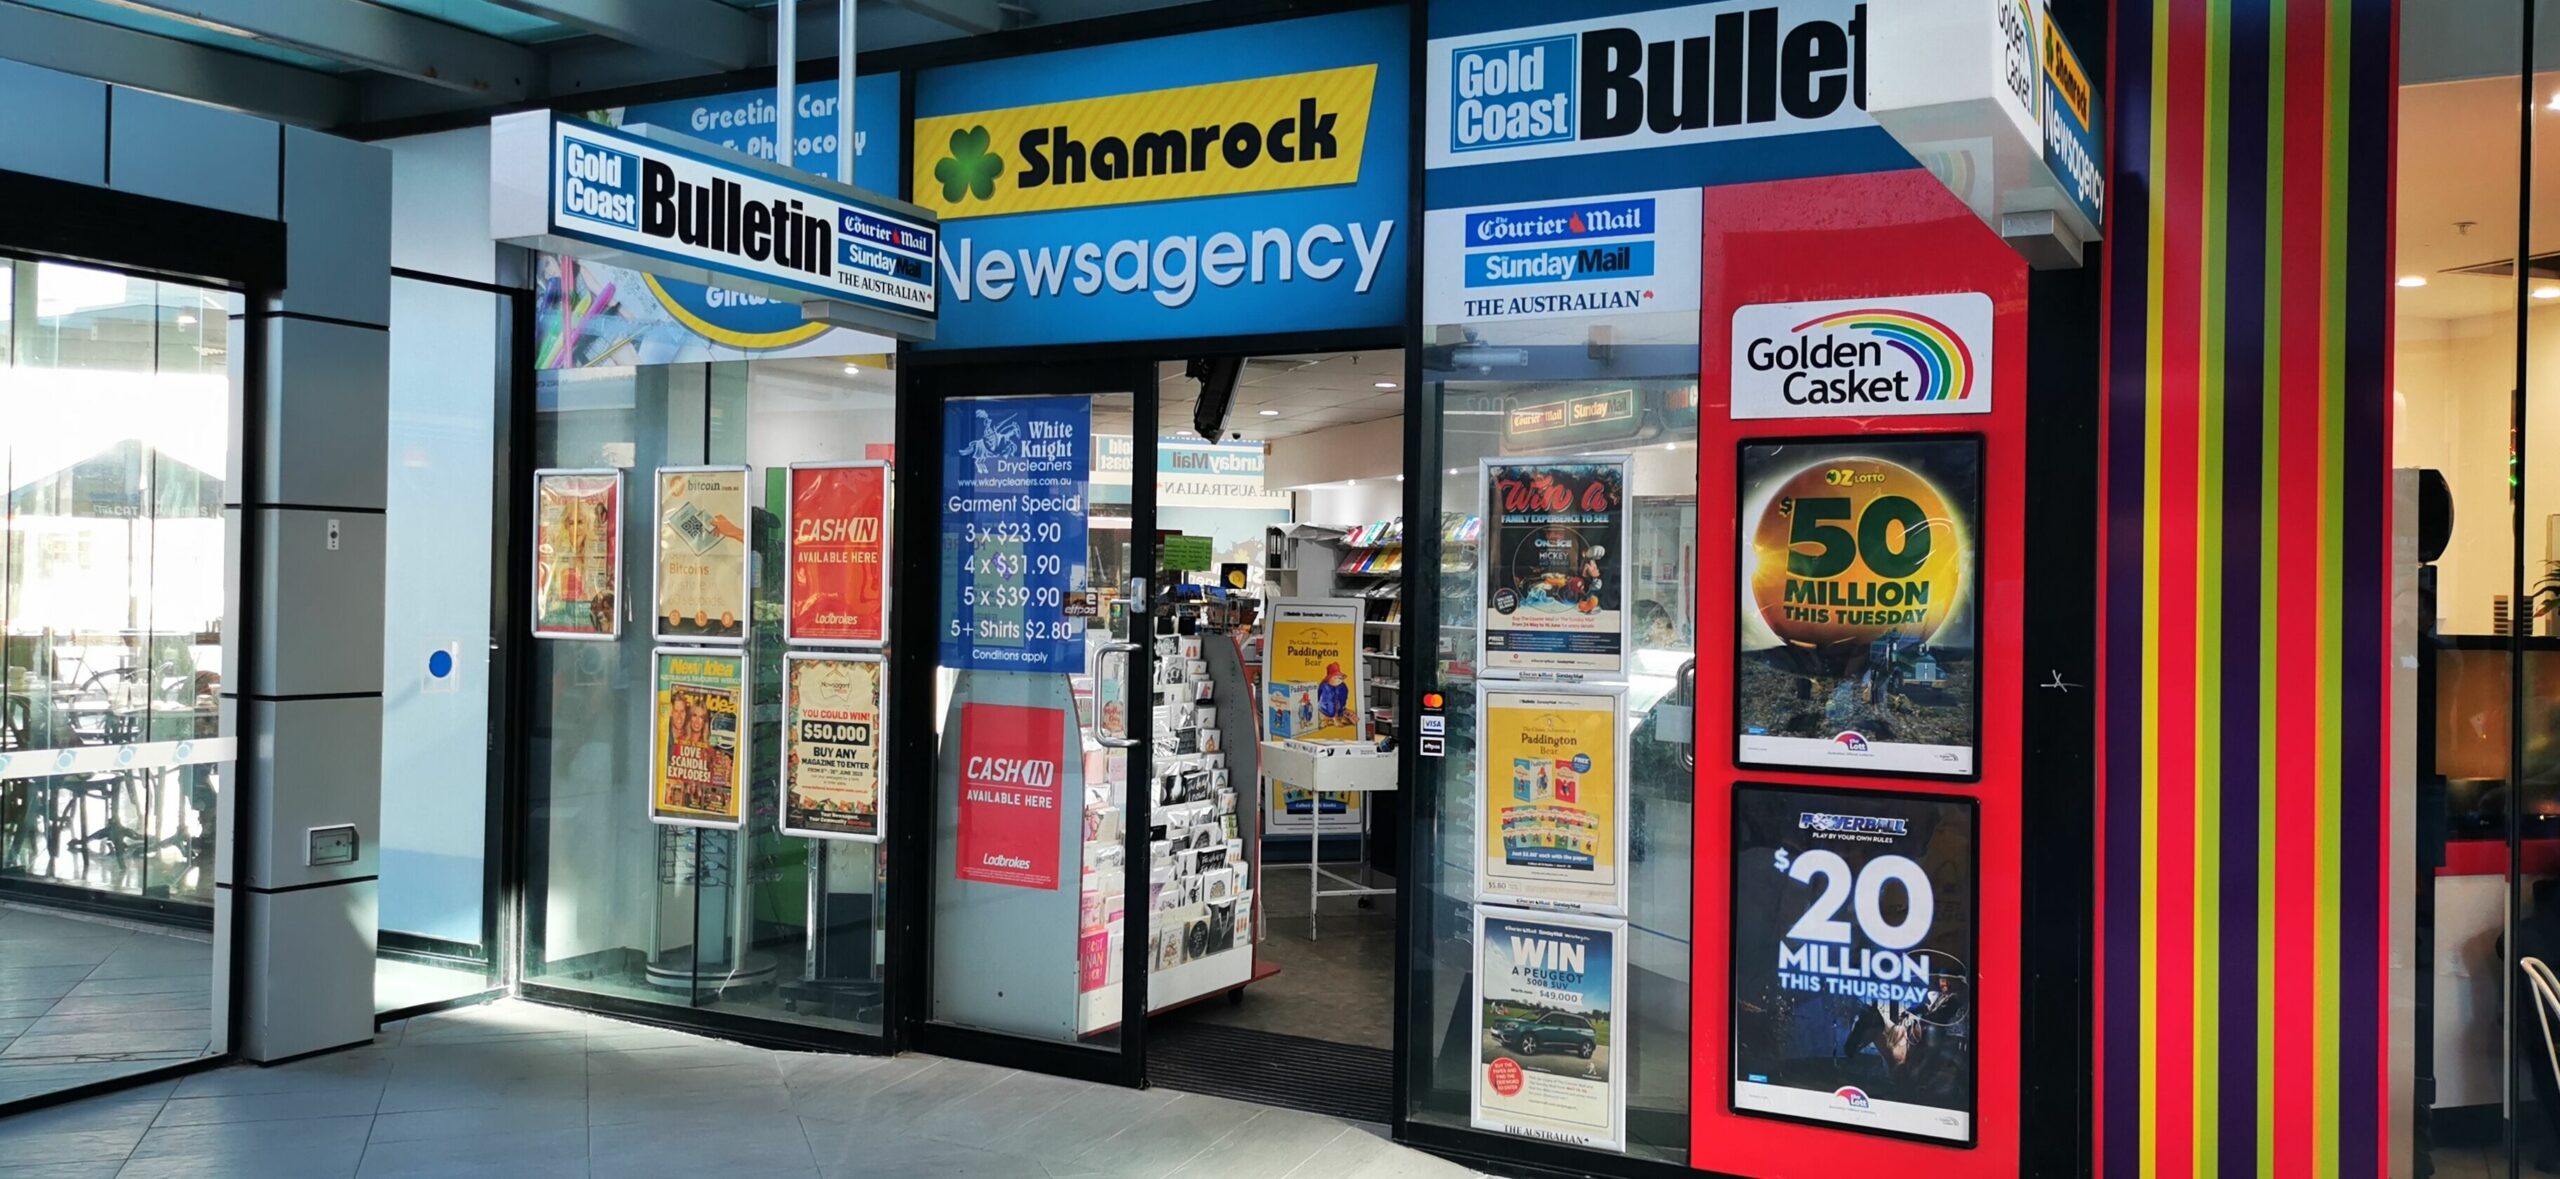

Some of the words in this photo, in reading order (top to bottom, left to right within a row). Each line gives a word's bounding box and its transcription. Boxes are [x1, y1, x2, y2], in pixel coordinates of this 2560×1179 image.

[1459, 46, 1544, 100] Gold
[2004, 41, 2032, 114] Casket
[691, 98, 778, 132] Greetin
[798, 94, 841, 119] Car
[1457, 92, 1568, 145] Coast
[1018, 96, 1338, 189] Shamrock
[2044, 81, 2105, 227] Newsagency
[567, 142, 622, 189] Gold
[567, 176, 636, 226] Coast
[641, 157, 832, 278] Bulletin
[1477, 215, 1569, 241] Courier
[1585, 207, 1642, 232] Mail
[844, 215, 893, 242] Courier
[900, 230, 928, 252] Mail
[938, 219, 1395, 307] Newsagency
[837, 271, 861, 288] THE
[860, 276, 926, 304] AUSTRALIAN
[1464, 298, 1504, 318] THE
[1507, 289, 1641, 315] AUSTRALIAN
[1747, 334, 1881, 372] Golden
[1782, 368, 1910, 406] Casket
[1028, 420, 1073, 439] White
[1020, 440, 1073, 462] Knight
[997, 459, 1073, 475] Drycleaners
[957, 477, 1072, 488] www.wkdrycleaners.com.au
[1854, 473, 1887, 484] LOTTO
[948, 496, 1017, 513] Garment
[1021, 495, 1081, 516] Special
[799, 518, 848, 543] CASH
[964, 523, 976, 543] 3
[981, 528, 992, 543] x
[997, 522, 1062, 546] $23.90
[798, 551, 848, 564] AVAILABLE
[851, 551, 878, 564] HERE
[963, 555, 975, 575] 4
[980, 560, 991, 575] x
[995, 553, 1060, 578] $31.90
[1539, 551, 1569, 561] MICKEY
[669, 562, 710, 576] Bitcoins
[963, 587, 975, 606] 5
[980, 591, 991, 606] x
[995, 586, 1060, 609] $39.90
[1784, 579, 1930, 608] MILLION
[815, 612, 858, 625] Ladbrokes
[1064, 603, 1097, 616] eftpos
[1783, 605, 1830, 624] THIS
[1835, 608, 1928, 626] TUESDAY
[950, 619, 974, 637] 5+
[979, 619, 1021, 639] Shirts
[1025, 620, 1072, 642] $2.80
[972, 649, 1019, 662] Conditions
[1021, 650, 1048, 664] apply
[1287, 646, 1339, 660] Paddington
[1305, 658, 1322, 667] Bear
[671, 657, 700, 675] New
[704, 659, 734, 678] Idea
[803, 709, 819, 718] YOU
[820, 710, 848, 720] COULD
[850, 711, 870, 721] WIN!
[1425, 720, 1442, 728] VISA
[803, 722, 867, 743] $50,000
[1521, 732, 1578, 749] Paddington
[680, 745, 701, 759] LOVE
[813, 746, 834, 757] BUY
[835, 748, 857, 759] ANY
[1540, 746, 1558, 755] Bear
[670, 755, 708, 771] SCANDAL
[801, 758, 836, 768] MAGAZINE
[836, 760, 846, 768] TO
[846, 761, 870, 770] ENTER
[967, 755, 1022, 783] CASH
[667, 765, 711, 783] EXPLODES!
[967, 789, 1021, 806] AVAILABLE
[1024, 795, 1053, 809] HERE
[1799, 811, 1908, 836] POWERBALL
[1837, 833, 1855, 841] YOUR
[1873, 836, 1893, 844] RULES
[982, 852, 1031, 870] Ladbrokes
[1510, 935, 1585, 975] WIN
[1778, 940, 1931, 985] MILLION
[1512, 966, 1520, 976] A
[1524, 967, 1584, 985] PEUGEOT
[1550, 981, 1569, 990] SUV
[1539, 989, 1578, 1003] $49,000
[1777, 971, 1821, 992] THIS
[1826, 977, 1929, 1004] THURSDAY
[1504, 1124, 1523, 1134] THE
[1523, 1127, 1584, 1145] AUSTRALIAN
